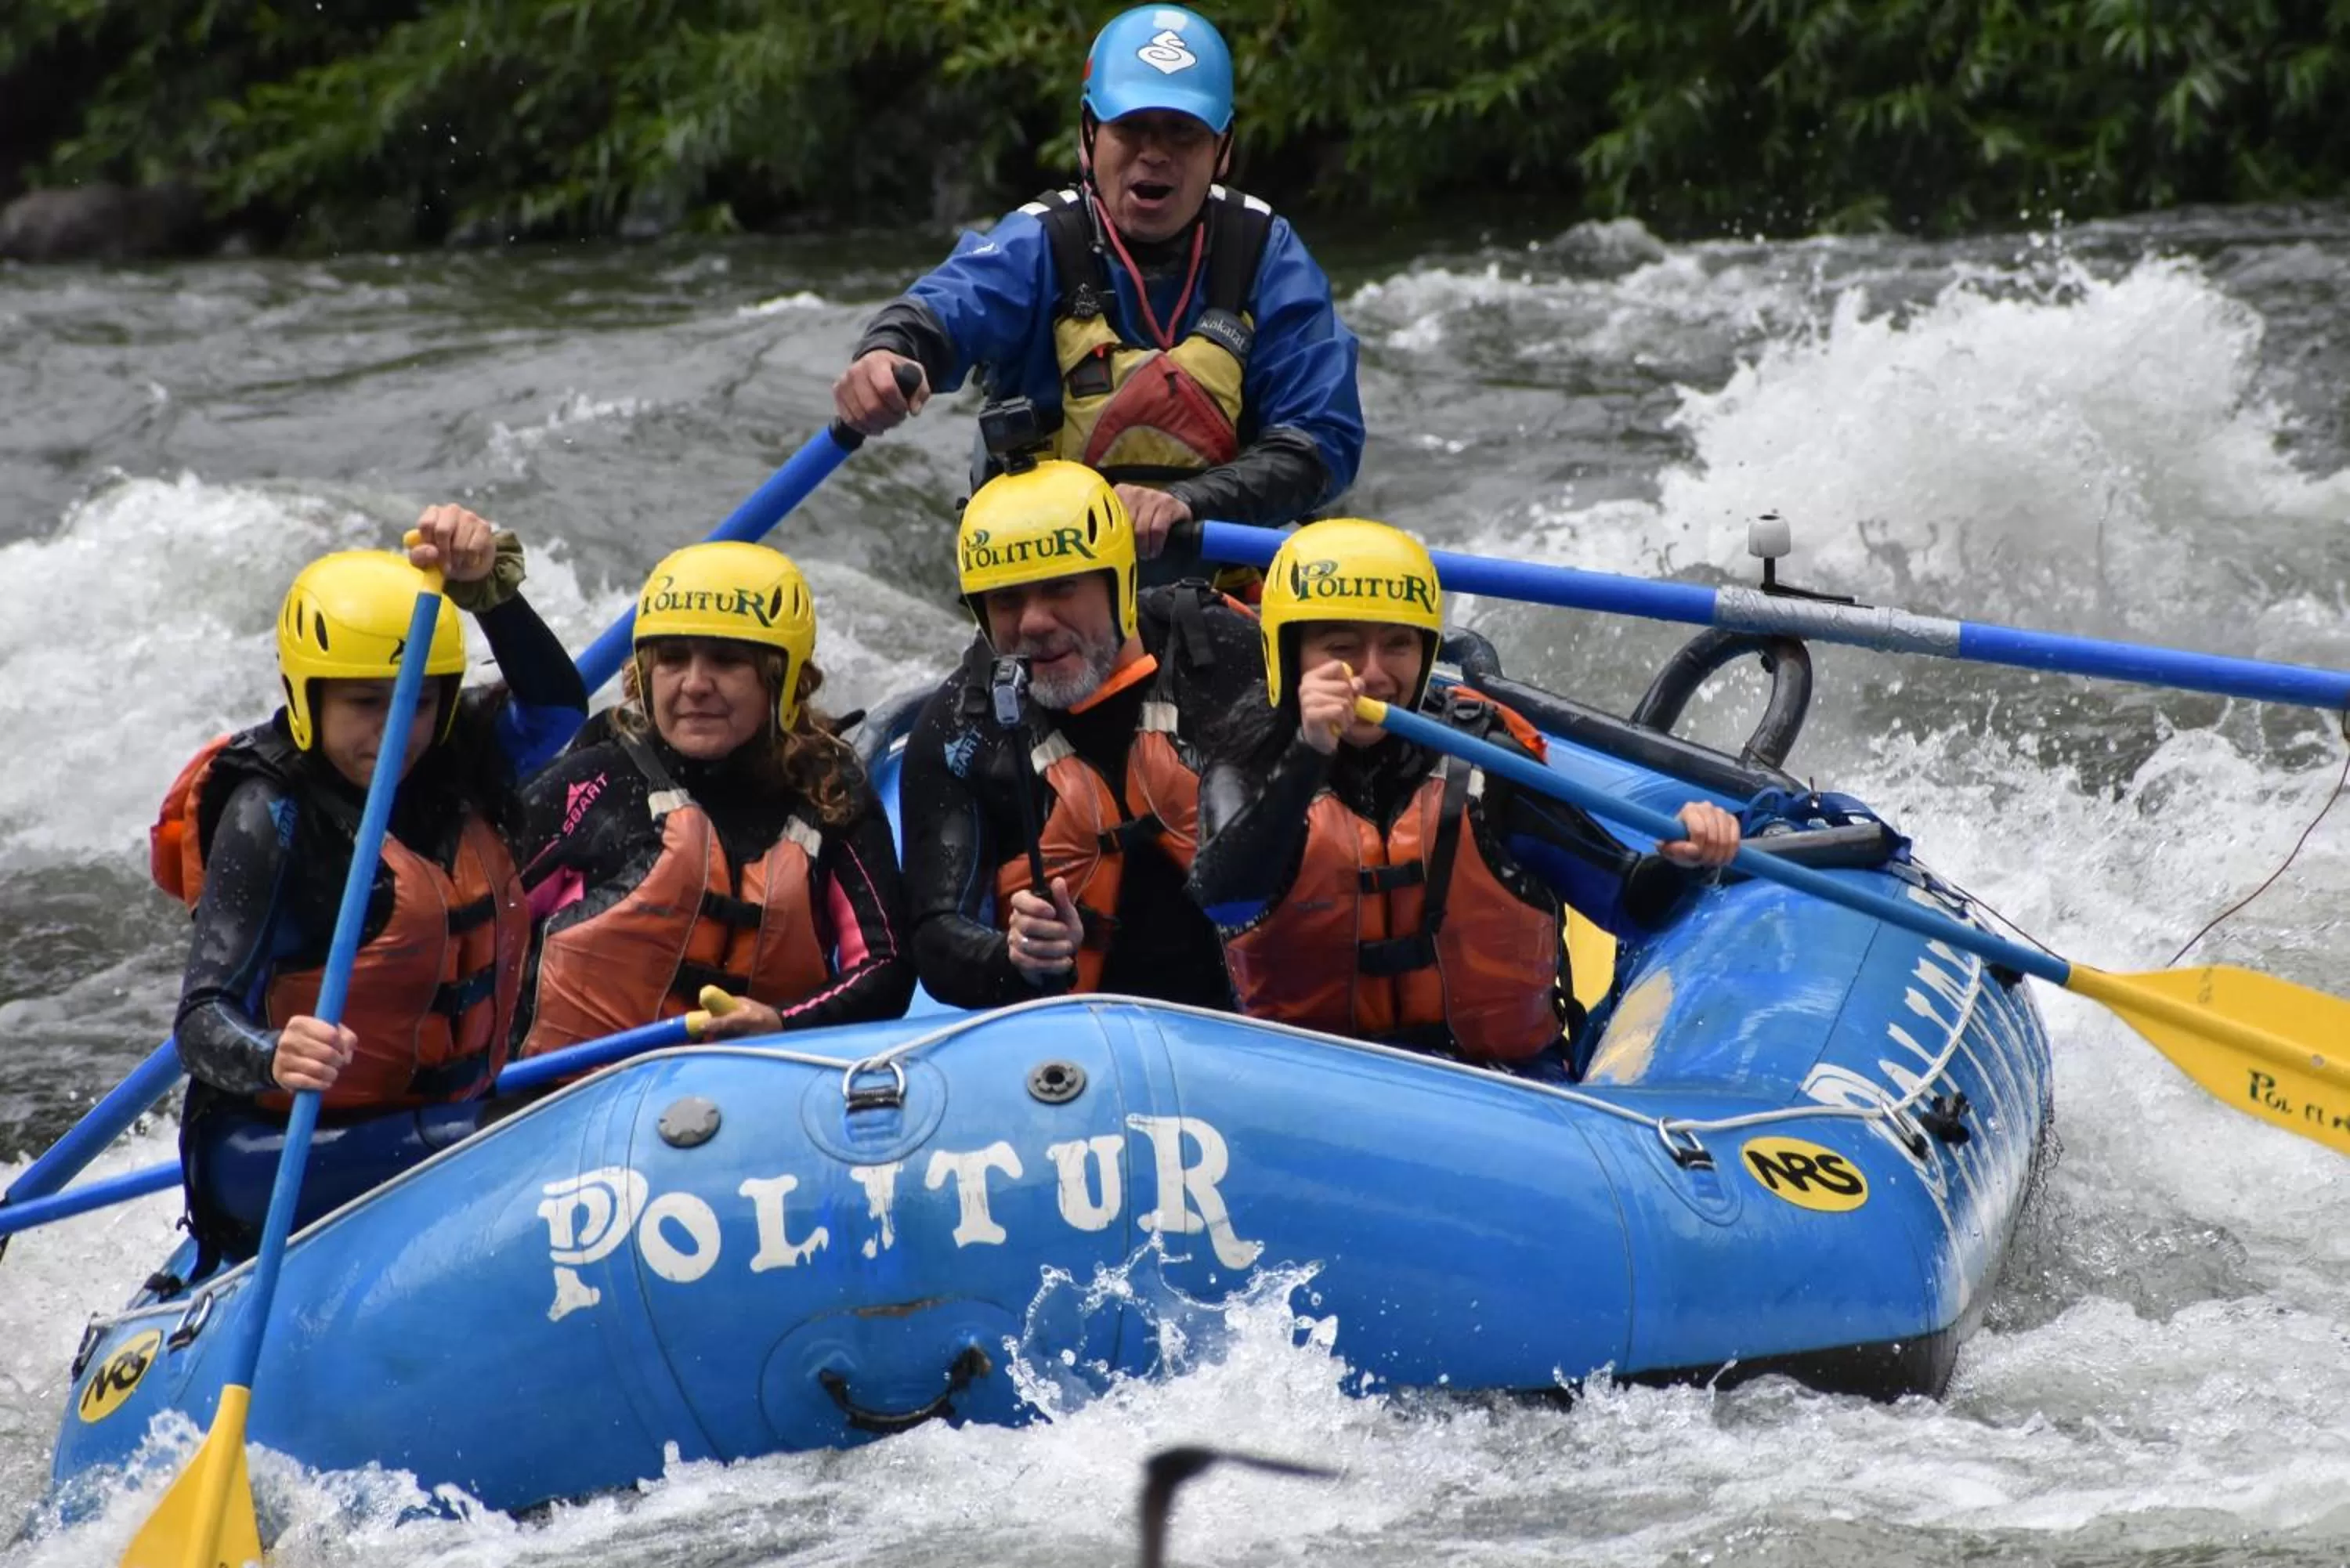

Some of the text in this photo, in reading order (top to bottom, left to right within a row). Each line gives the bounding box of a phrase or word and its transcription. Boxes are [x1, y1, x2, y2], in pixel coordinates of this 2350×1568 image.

[1296, 559, 1434, 614] POLITUR
[1747, 1150, 1864, 1195] NRS
[538, 1115, 1261, 1322] POLITUR
